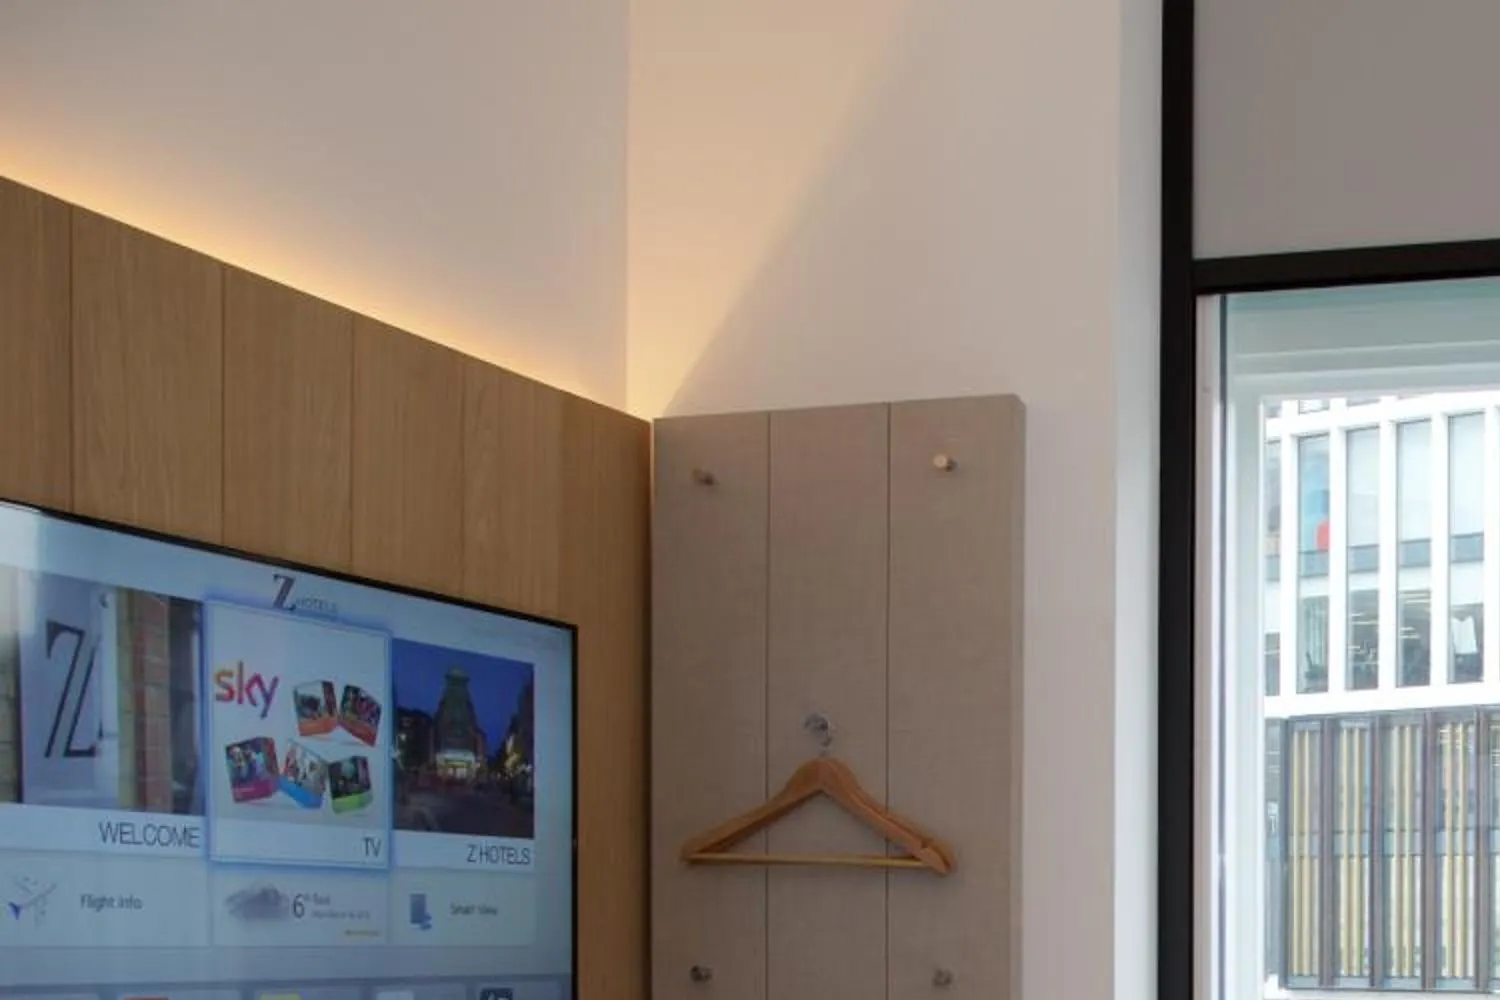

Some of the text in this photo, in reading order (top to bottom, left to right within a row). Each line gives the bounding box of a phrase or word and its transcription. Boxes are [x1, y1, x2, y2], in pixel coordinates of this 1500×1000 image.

[214, 660, 279, 720] sky
[98, 821, 200, 848] WELCOME
[362, 836, 381, 857] TV
[466, 844, 530, 865] Z HOTELS
